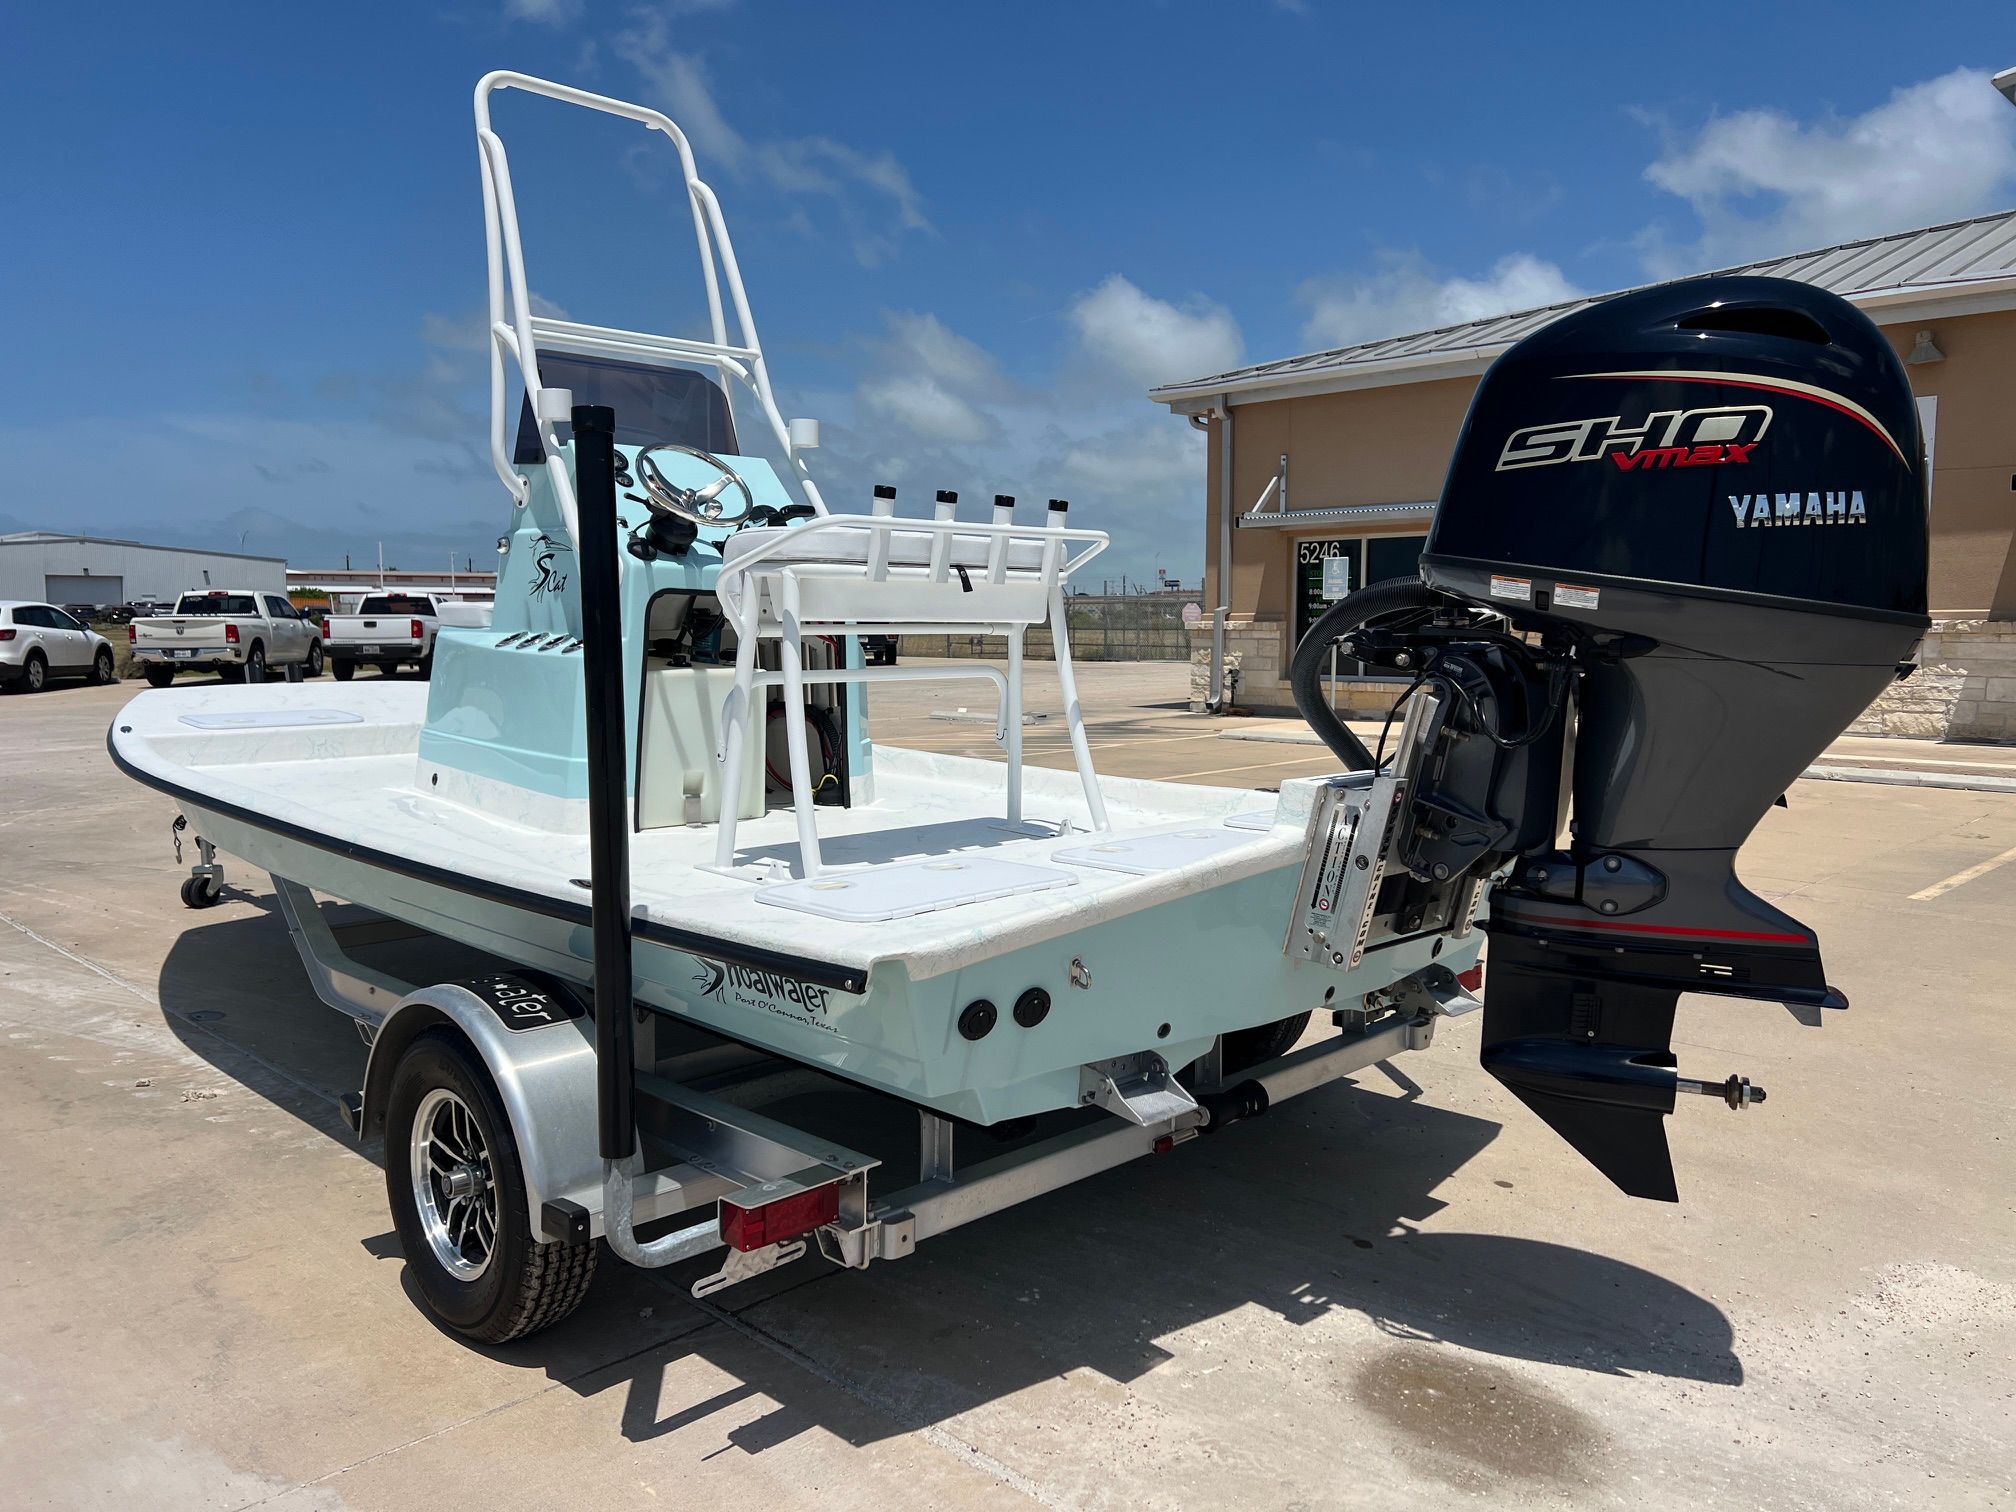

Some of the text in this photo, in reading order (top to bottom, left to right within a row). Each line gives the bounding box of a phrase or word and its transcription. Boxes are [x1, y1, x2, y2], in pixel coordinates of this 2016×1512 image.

[1495, 405, 1774, 472] SHO
[1728, 490, 1868, 529] YAMAHA
[1300, 542, 1340, 563] 5246
[1323, 814, 1349, 897] ACTION
[735, 991, 757, 1008] Port
[809, 1015, 839, 1034] Texas
